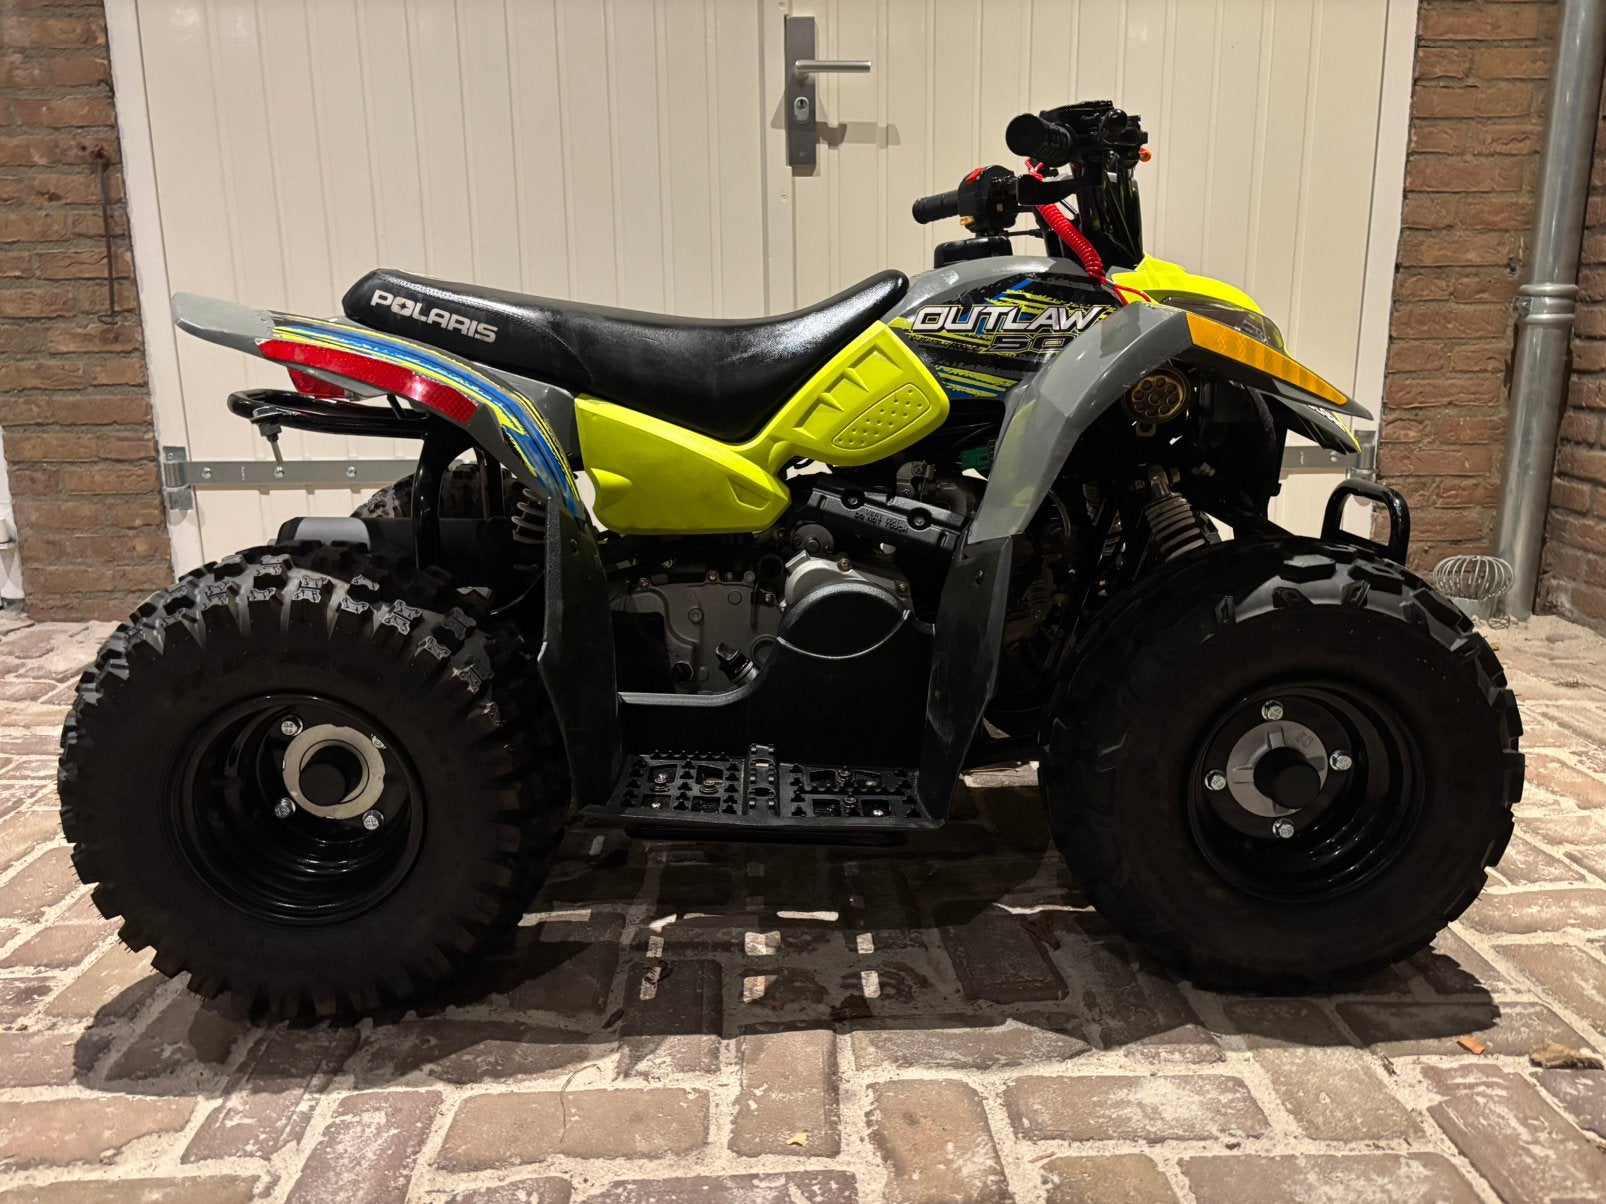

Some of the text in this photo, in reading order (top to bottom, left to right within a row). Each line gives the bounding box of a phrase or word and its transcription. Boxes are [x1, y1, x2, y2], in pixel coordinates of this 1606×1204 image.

[370, 289, 498, 343] POLARIS
[911, 305, 1102, 331] OUTLAW
[988, 333, 1075, 351] 50
